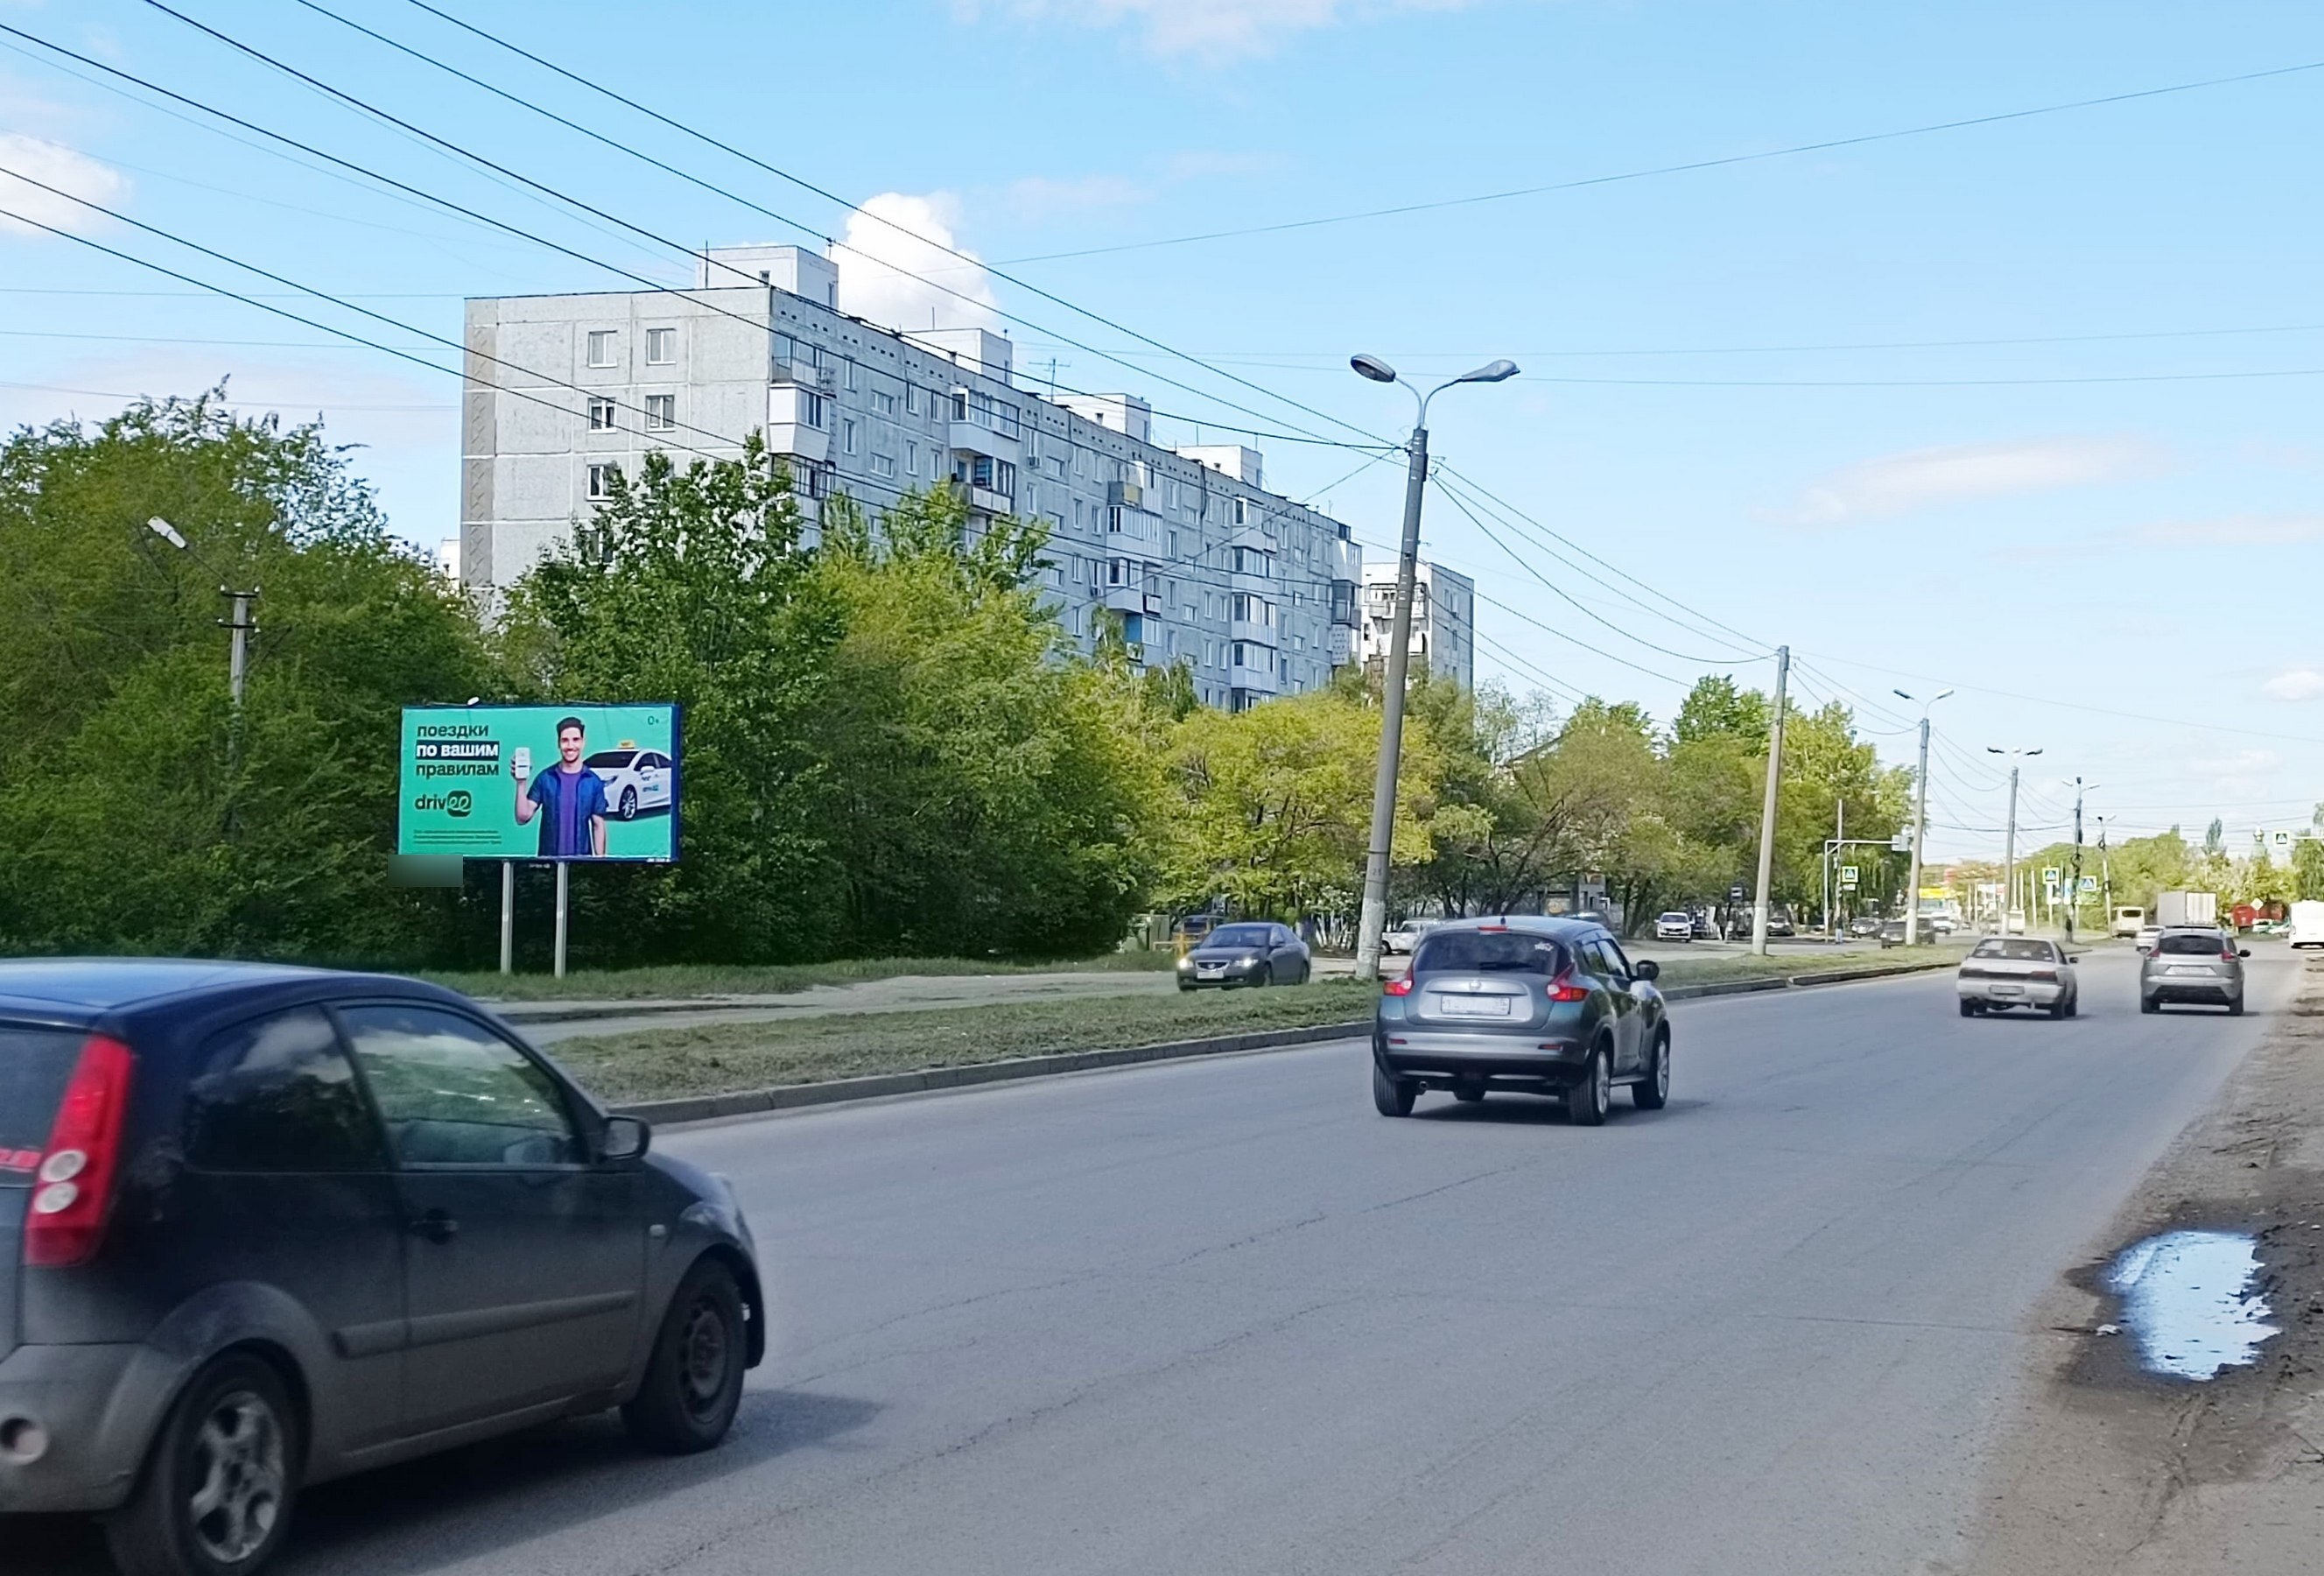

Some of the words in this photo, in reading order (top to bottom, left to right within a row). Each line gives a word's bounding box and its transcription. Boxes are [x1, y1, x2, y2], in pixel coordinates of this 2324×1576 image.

[418, 725, 488, 738] поездки
[416, 744, 438, 757] по
[440, 744, 499, 757] вашим
[416, 764, 499, 780] правилам
[415, 793, 471, 813] drivee
